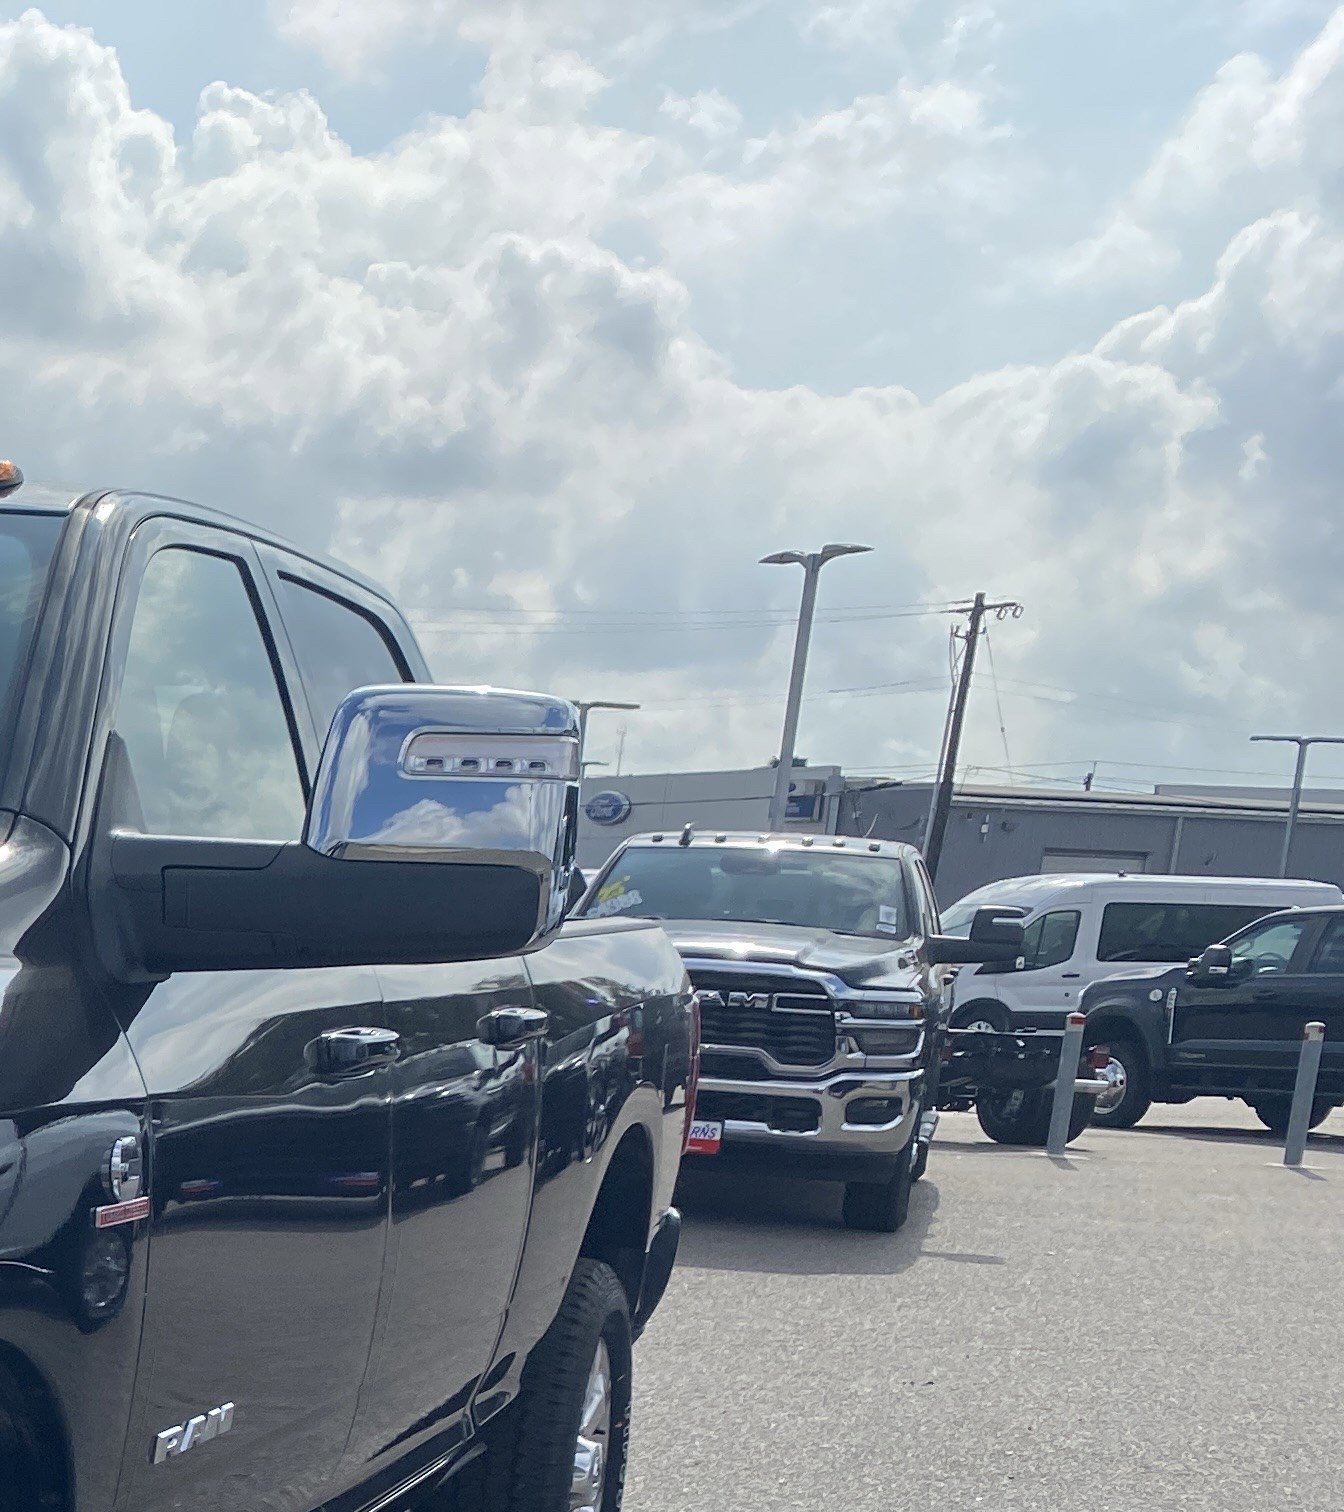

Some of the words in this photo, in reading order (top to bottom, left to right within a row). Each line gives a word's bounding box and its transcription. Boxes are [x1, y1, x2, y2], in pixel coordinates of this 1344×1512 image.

[694, 990, 771, 1009] AM
[690, 1125, 718, 1139] RNS
[152, 1401, 235, 1465] RAM
